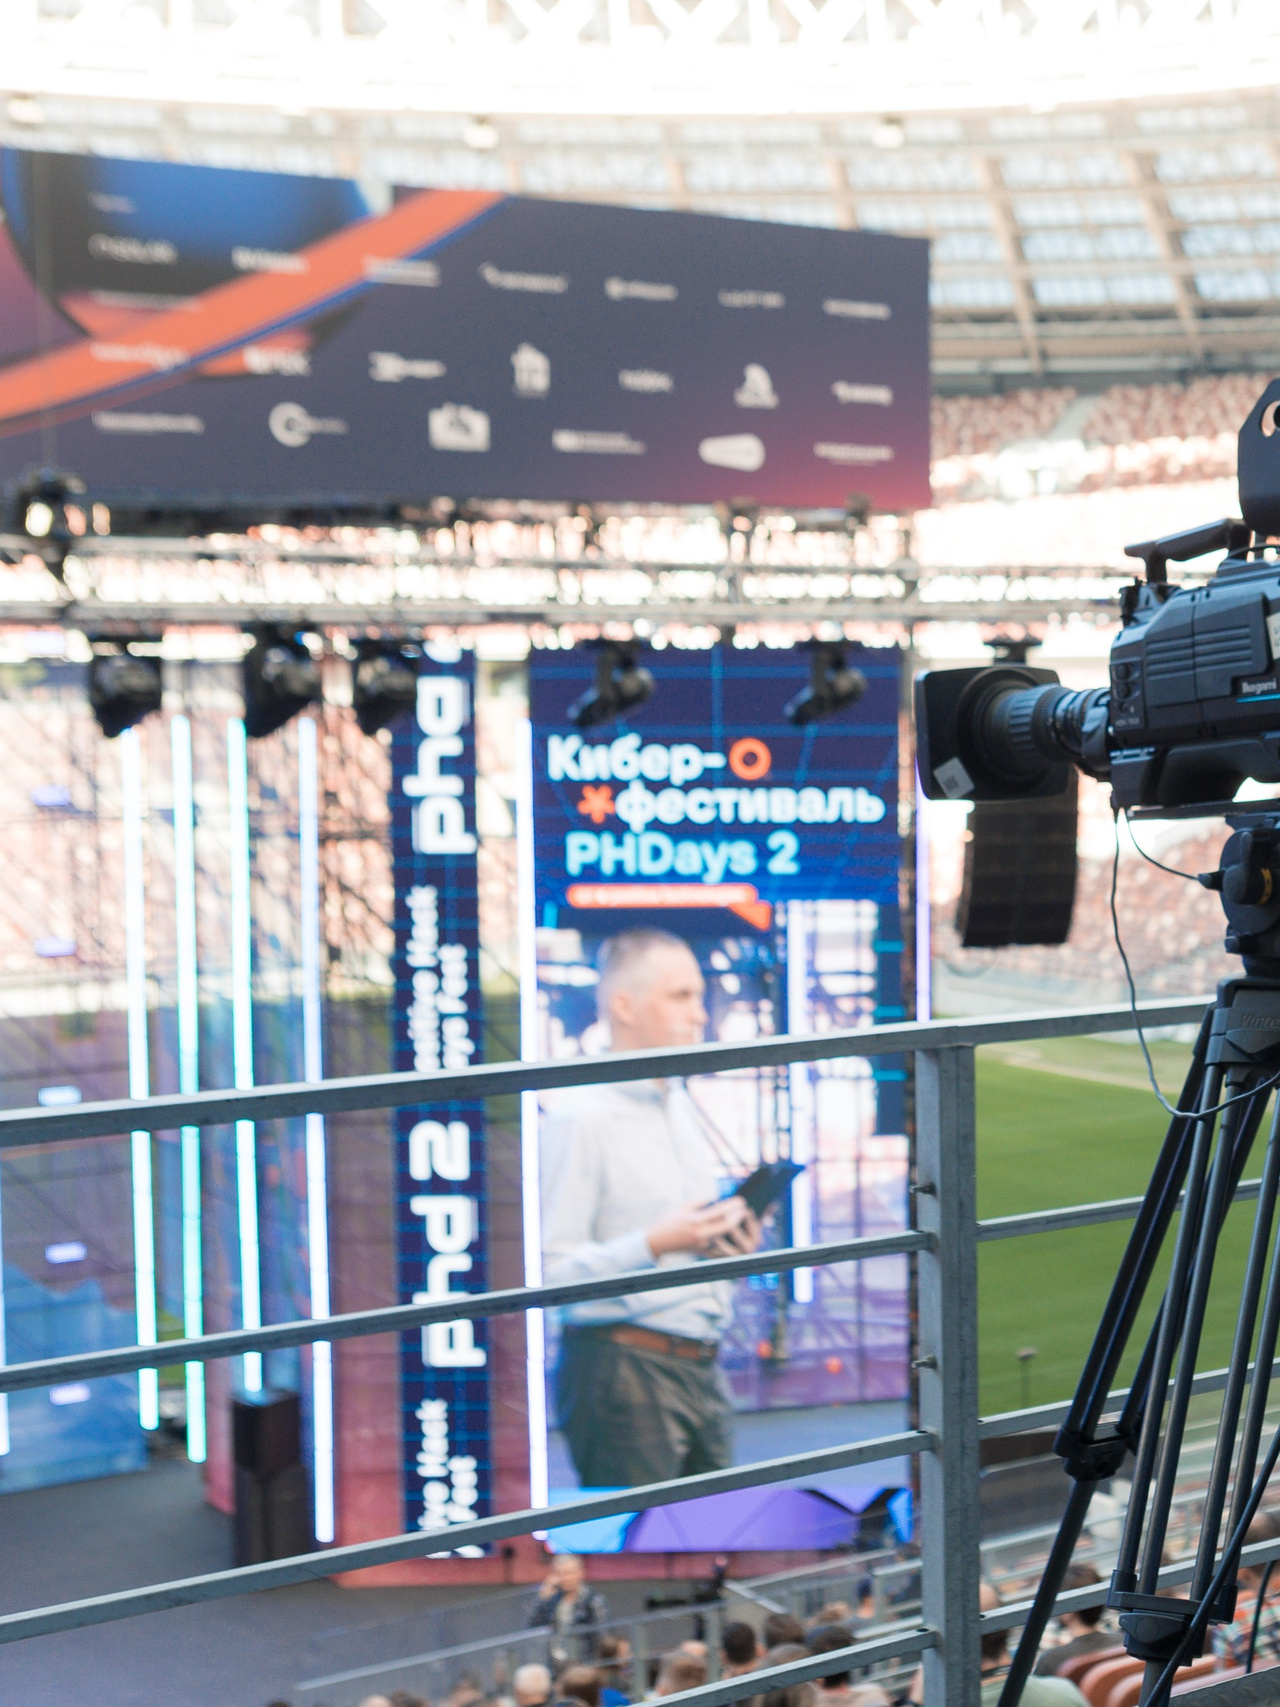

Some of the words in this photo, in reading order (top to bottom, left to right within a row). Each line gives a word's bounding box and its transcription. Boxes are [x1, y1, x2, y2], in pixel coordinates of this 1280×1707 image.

[1241, 678, 1277, 695] Ikegami
[547, 732, 727, 787] Кибер-
[564, 830, 758, 885] PHDays
[766, 828, 800, 875] 2
[407, 969, 441, 1071] ositive
[408, 1119, 471, 1181] 2
[409, 1195, 487, 1368] phd
